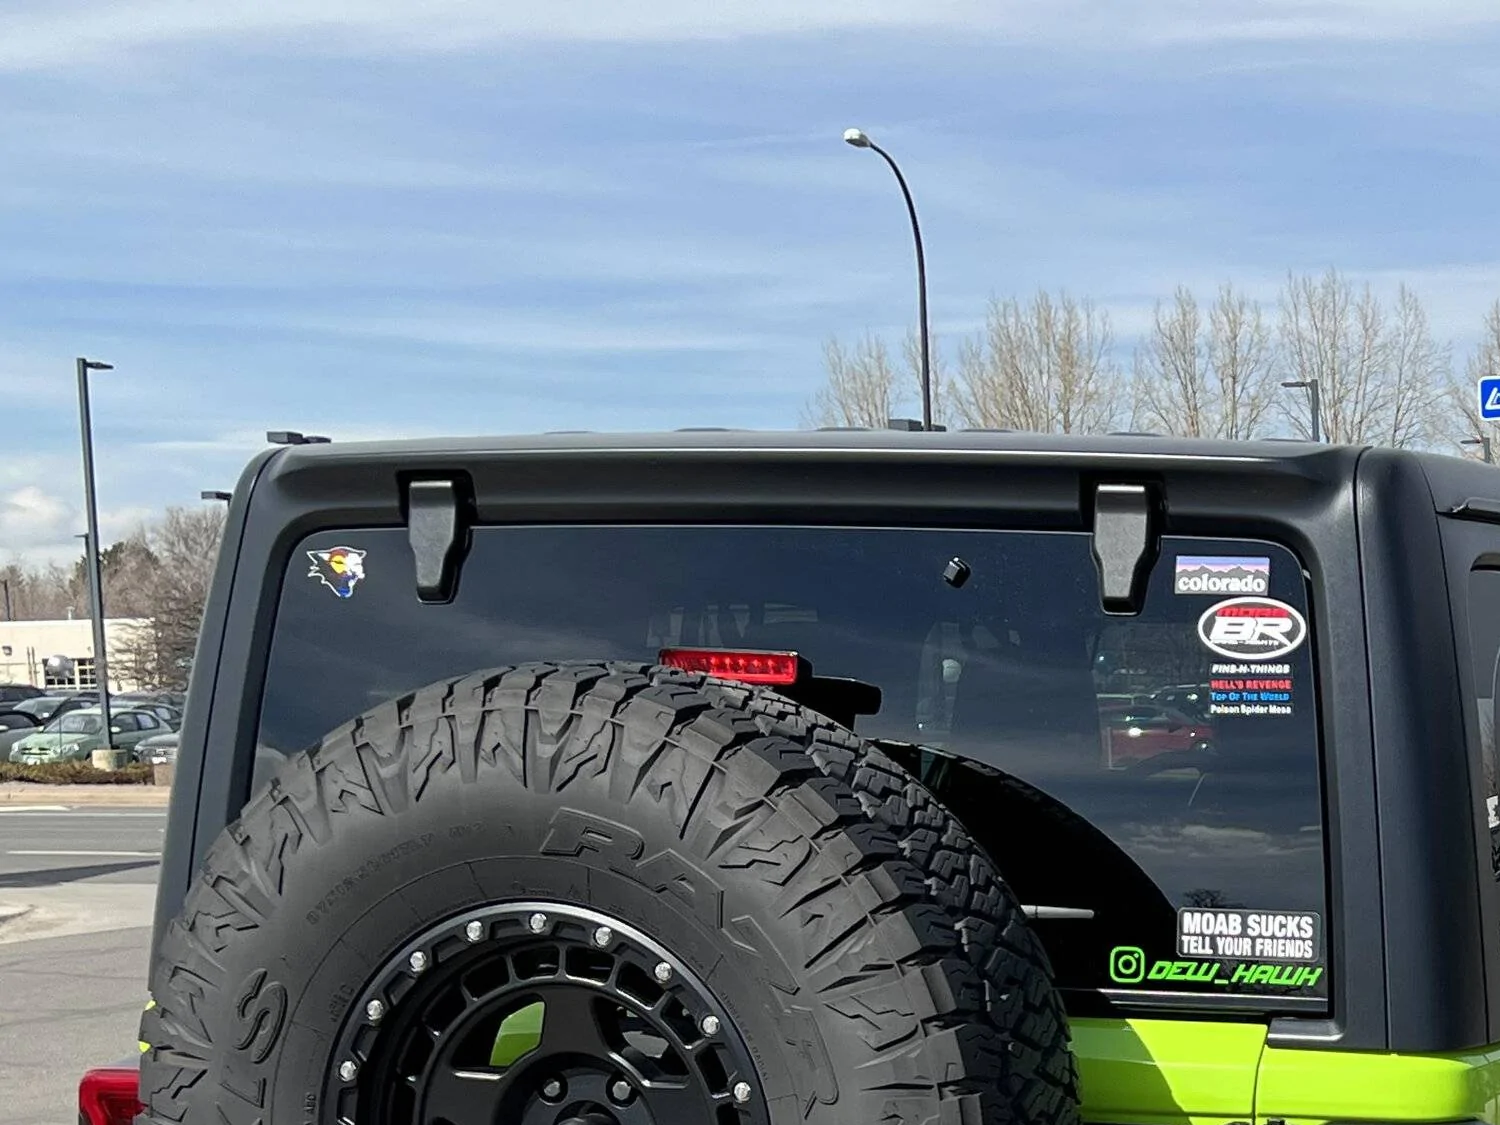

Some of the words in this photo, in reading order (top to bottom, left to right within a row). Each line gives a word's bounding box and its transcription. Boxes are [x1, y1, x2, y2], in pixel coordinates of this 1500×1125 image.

[1177, 572, 1267, 593] colorado
[1184, 912, 1242, 935] MOAB
[1247, 914, 1313, 938] SUCKS
[1182, 935, 1214, 954] TELL
[1217, 936, 1252, 956] YOUR
[1255, 938, 1313, 958] FRIENDS
